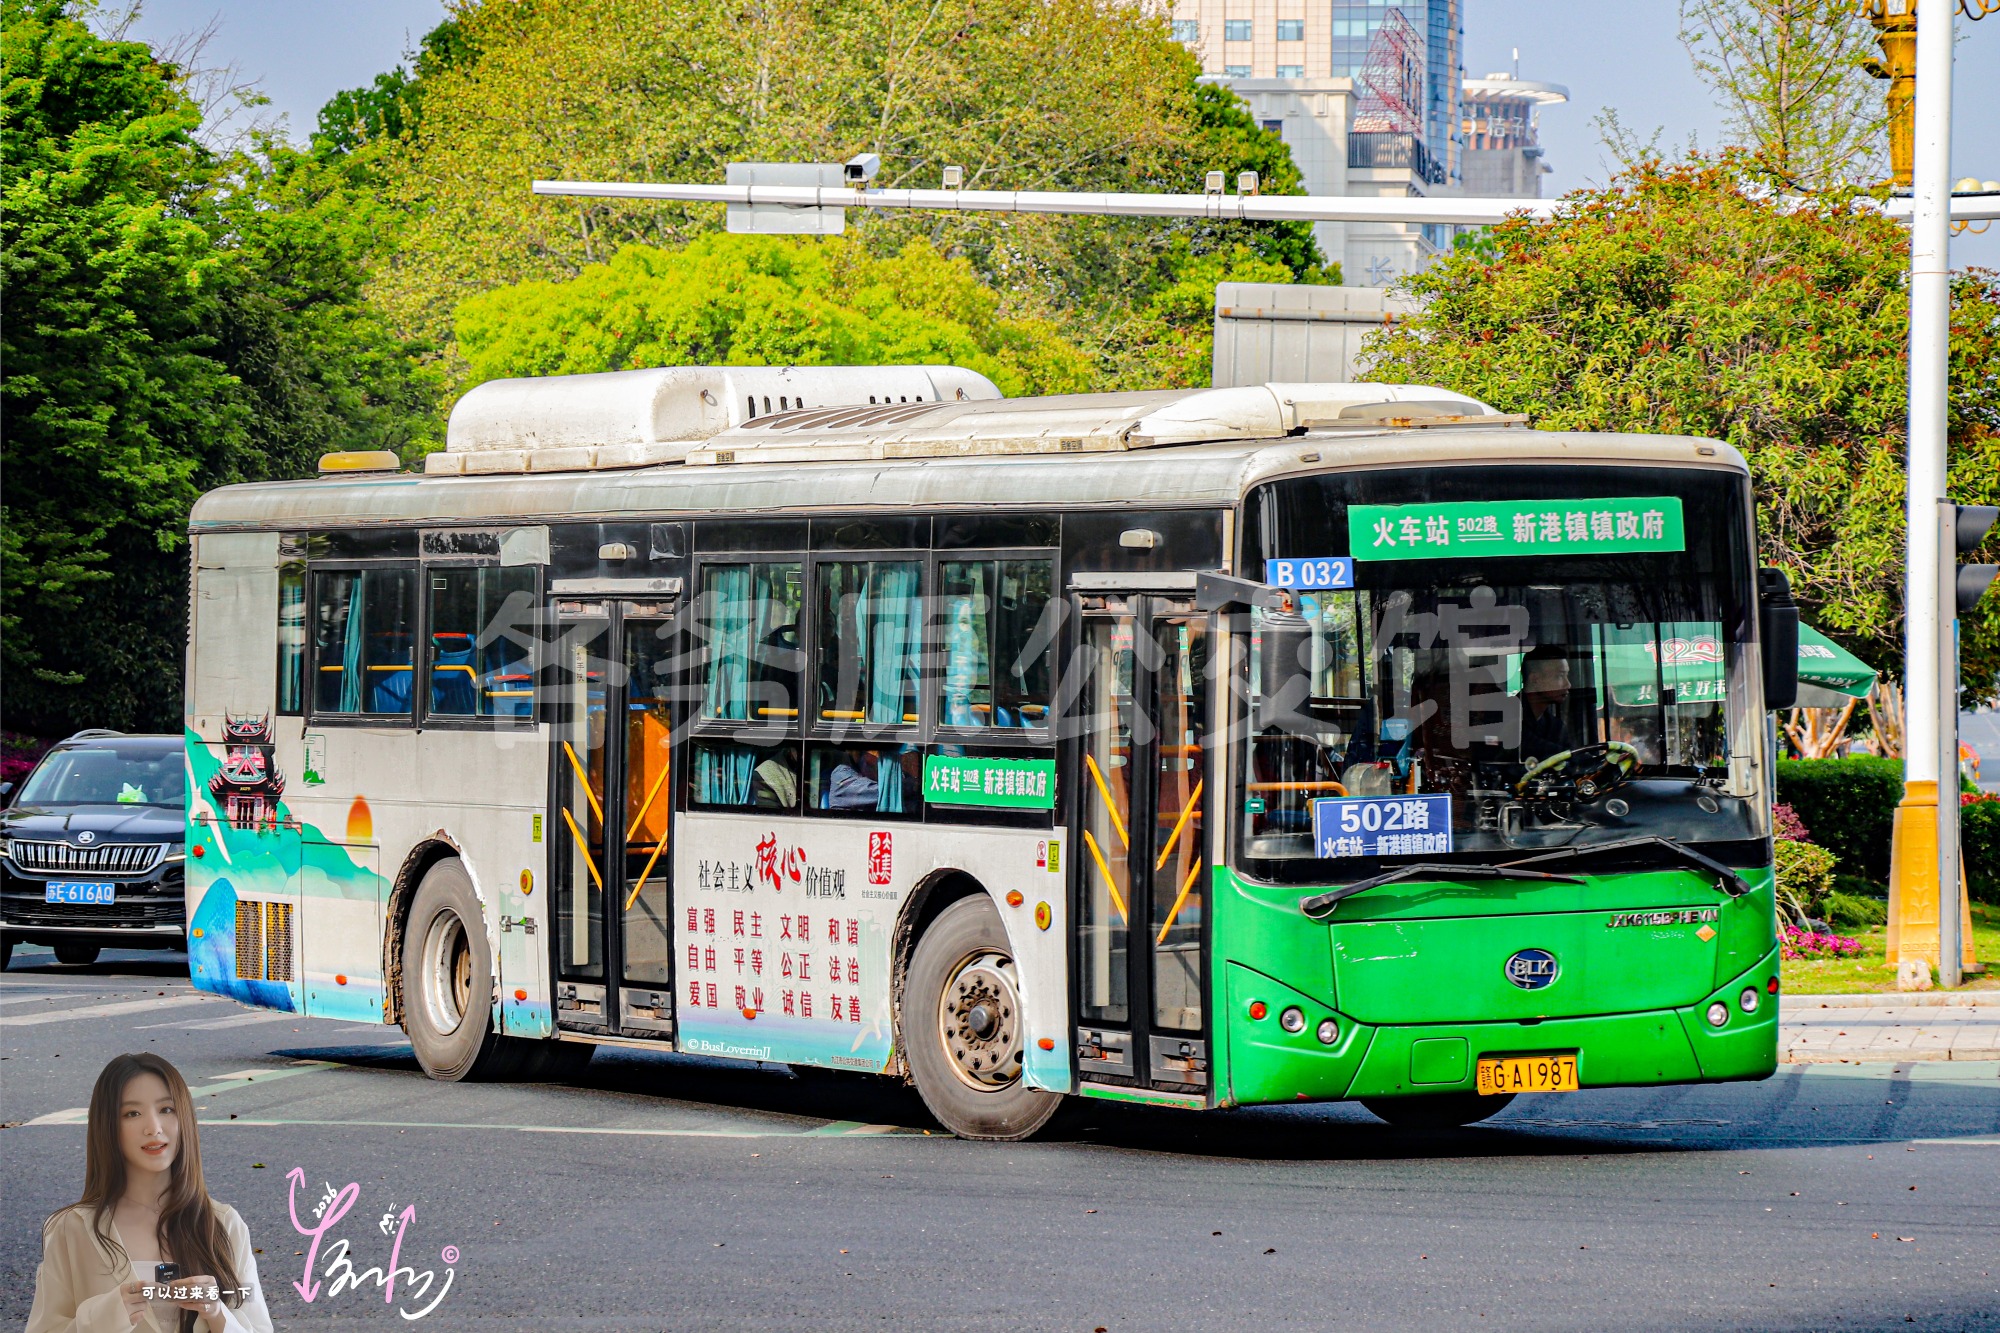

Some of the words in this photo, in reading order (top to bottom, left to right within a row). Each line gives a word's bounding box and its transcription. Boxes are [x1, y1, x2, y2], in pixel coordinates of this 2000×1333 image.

[1372, 515, 1450, 548] 火车站
[1457, 516, 1498, 535] 502路
[1512, 509, 1665, 545] 新港镇镇政府
[1277, 562, 1295, 586] B
[1301, 561, 1346, 586] 032
[930, 765, 961, 793] 火车站
[984, 768, 1047, 797] 新港镇镇政府
[1340, 800, 1430, 833] 502路
[1323, 836, 1364, 858] 火车站
[1376, 832, 1448, 856] 新港镇镇政府
[687, 906, 716, 935] 富强
[733, 909, 763, 938] 民主
[780, 913, 810, 942] 文明
[828, 917, 859, 945] 和谐
[687, 944, 717, 972] 自由
[733, 947, 763, 976] 平等
[781, 951, 811, 980] 公正
[829, 955, 860, 984] 法治
[1514, 960, 1553, 976] BLK
[689, 981, 718, 1009] 爱国
[735, 984, 765, 1013] 敬业
[782, 989, 812, 1018] 诚信
[830, 993, 861, 1023] 友善
